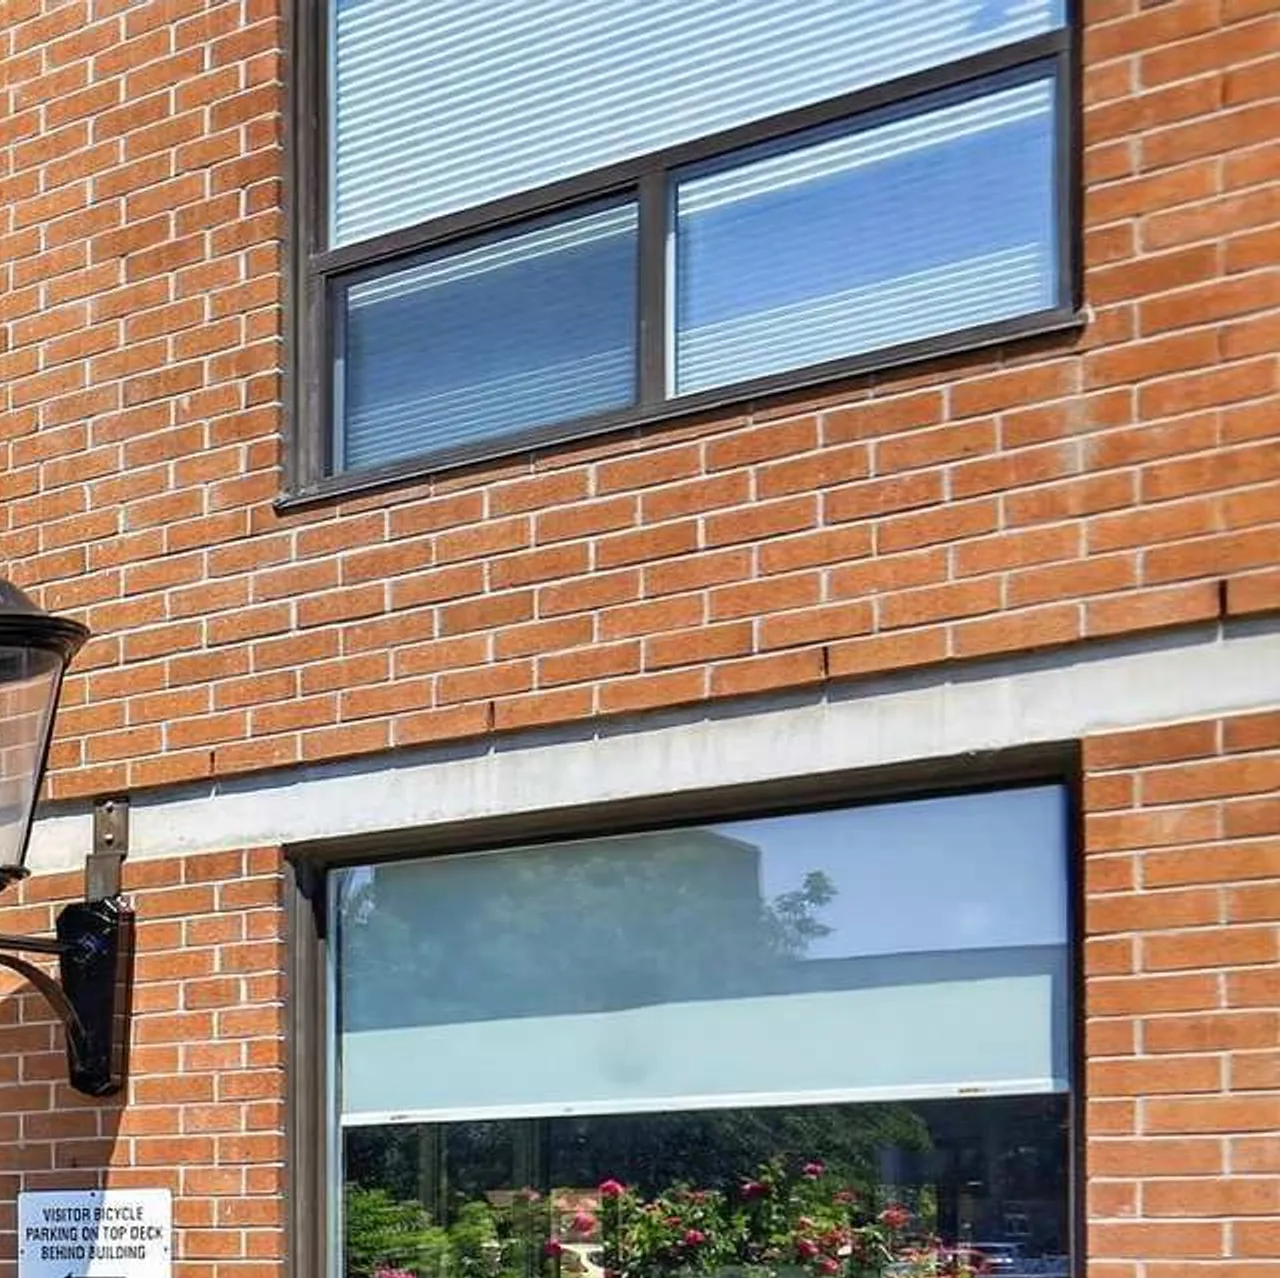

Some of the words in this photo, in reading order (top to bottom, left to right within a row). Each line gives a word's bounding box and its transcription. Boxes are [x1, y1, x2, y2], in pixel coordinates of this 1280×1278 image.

[41, 1207, 91, 1223] VISITOR
[93, 1206, 144, 1222] BICYCLE
[25, 1226, 78, 1242] PARKING
[81, 1226, 99, 1242] ON
[103, 1225, 128, 1241] TOP
[130, 1225, 163, 1241] DECK
[40, 1245, 86, 1260] BEHIND
[88, 1244, 147, 1260] BUILDING
